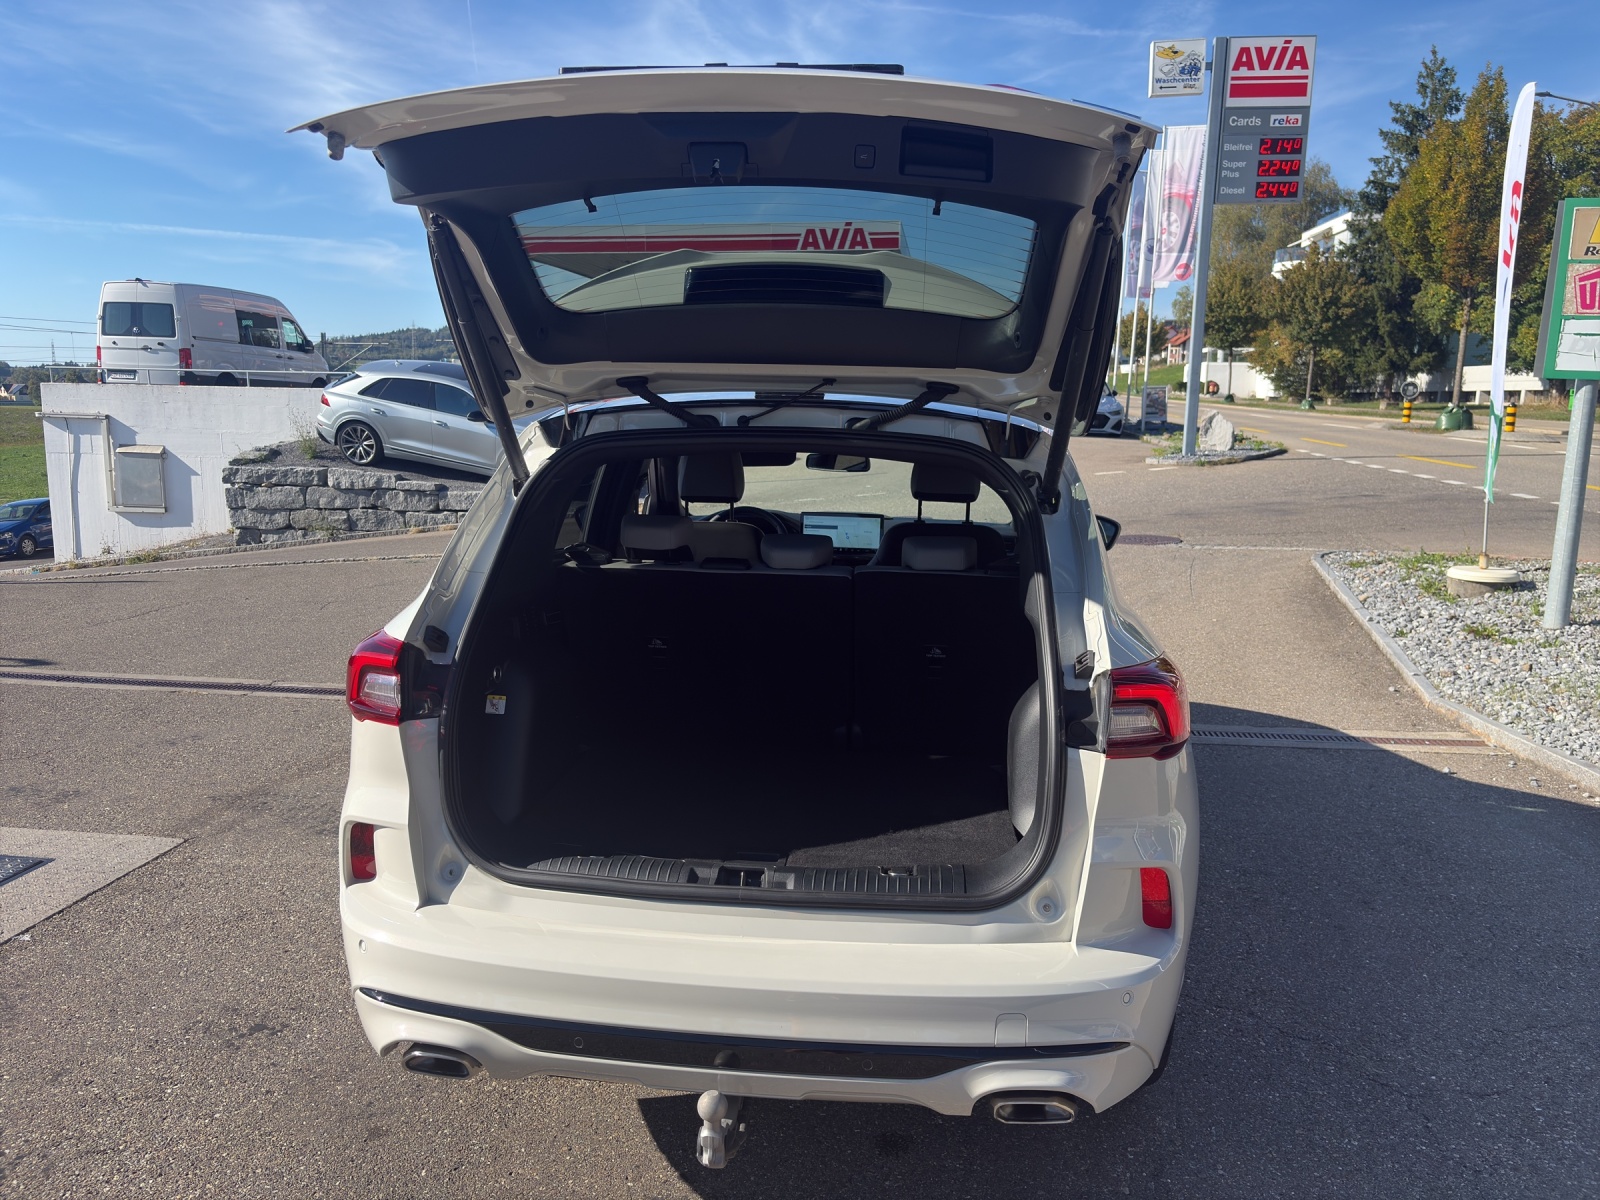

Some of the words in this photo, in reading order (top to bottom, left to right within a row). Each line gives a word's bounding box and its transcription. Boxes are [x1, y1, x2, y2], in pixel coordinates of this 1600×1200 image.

[1231, 39, 1309, 71] AVIA
[1229, 116, 1262, 126] Cards
[1272, 115, 1299, 126] reka
[1223, 143, 1253, 151] Bleifrei
[1222, 160, 1247, 169] Super
[1220, 186, 1245, 194] Diesel
[800, 221, 869, 251] AVIA
